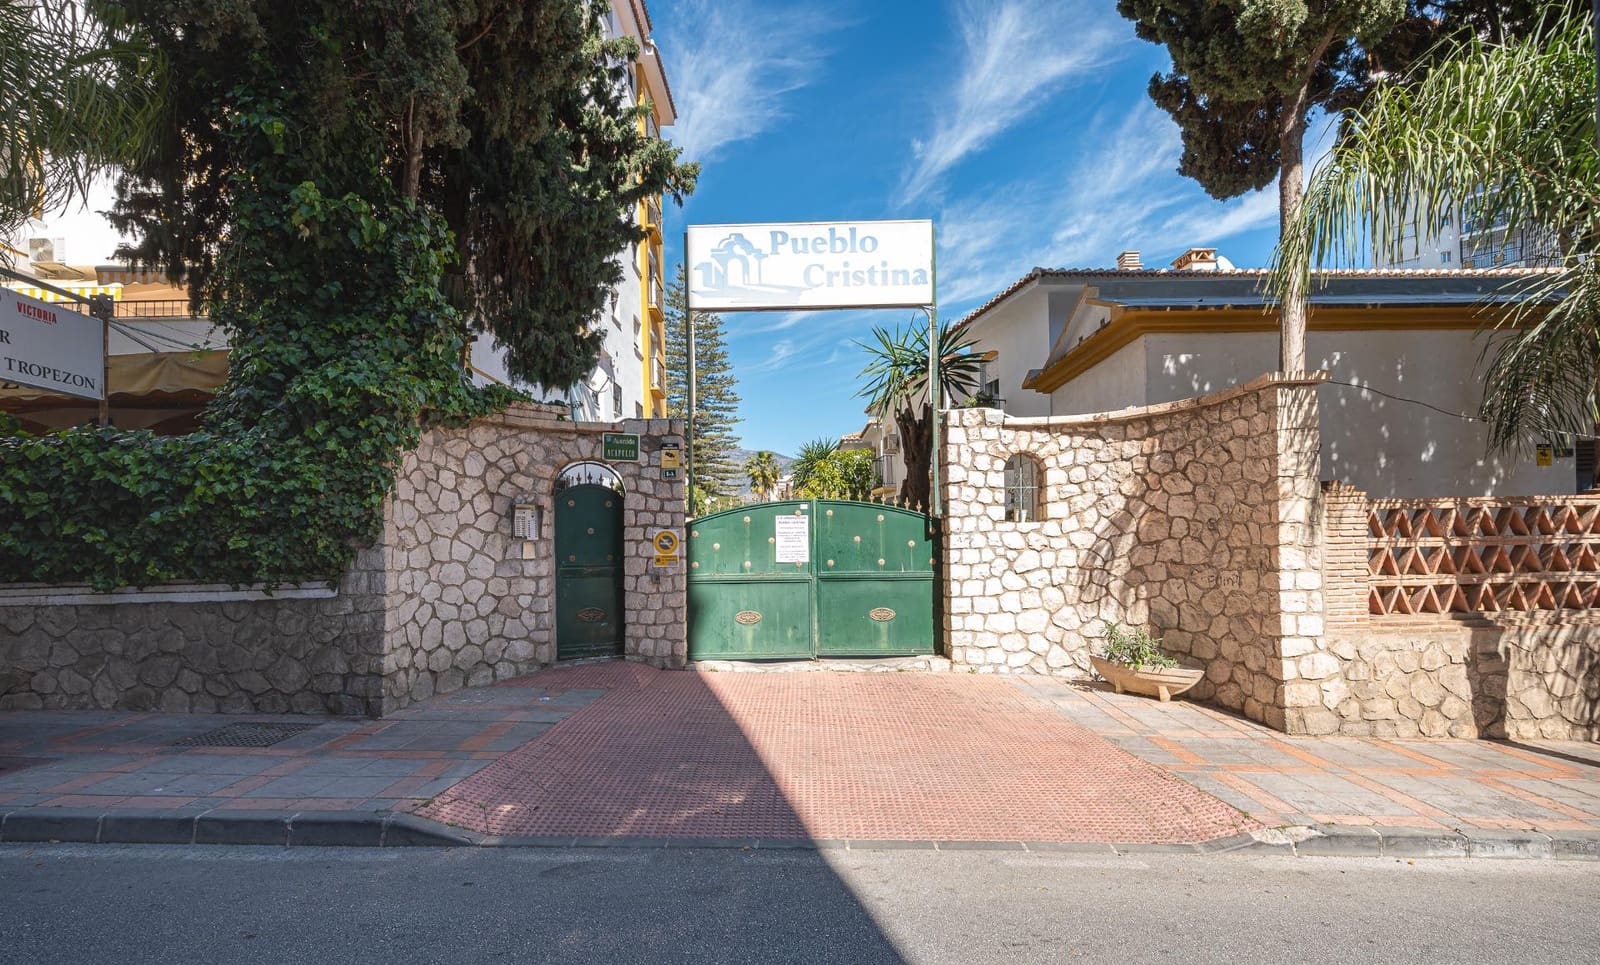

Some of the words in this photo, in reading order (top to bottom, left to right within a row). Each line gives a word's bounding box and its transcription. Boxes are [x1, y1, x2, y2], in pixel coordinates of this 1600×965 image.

[769, 226, 879, 256] Pueblo
[803, 260, 929, 288] Cristina
[16, 301, 57, 324] VICTORIA
[4, 357, 96, 390] TROPEZON
